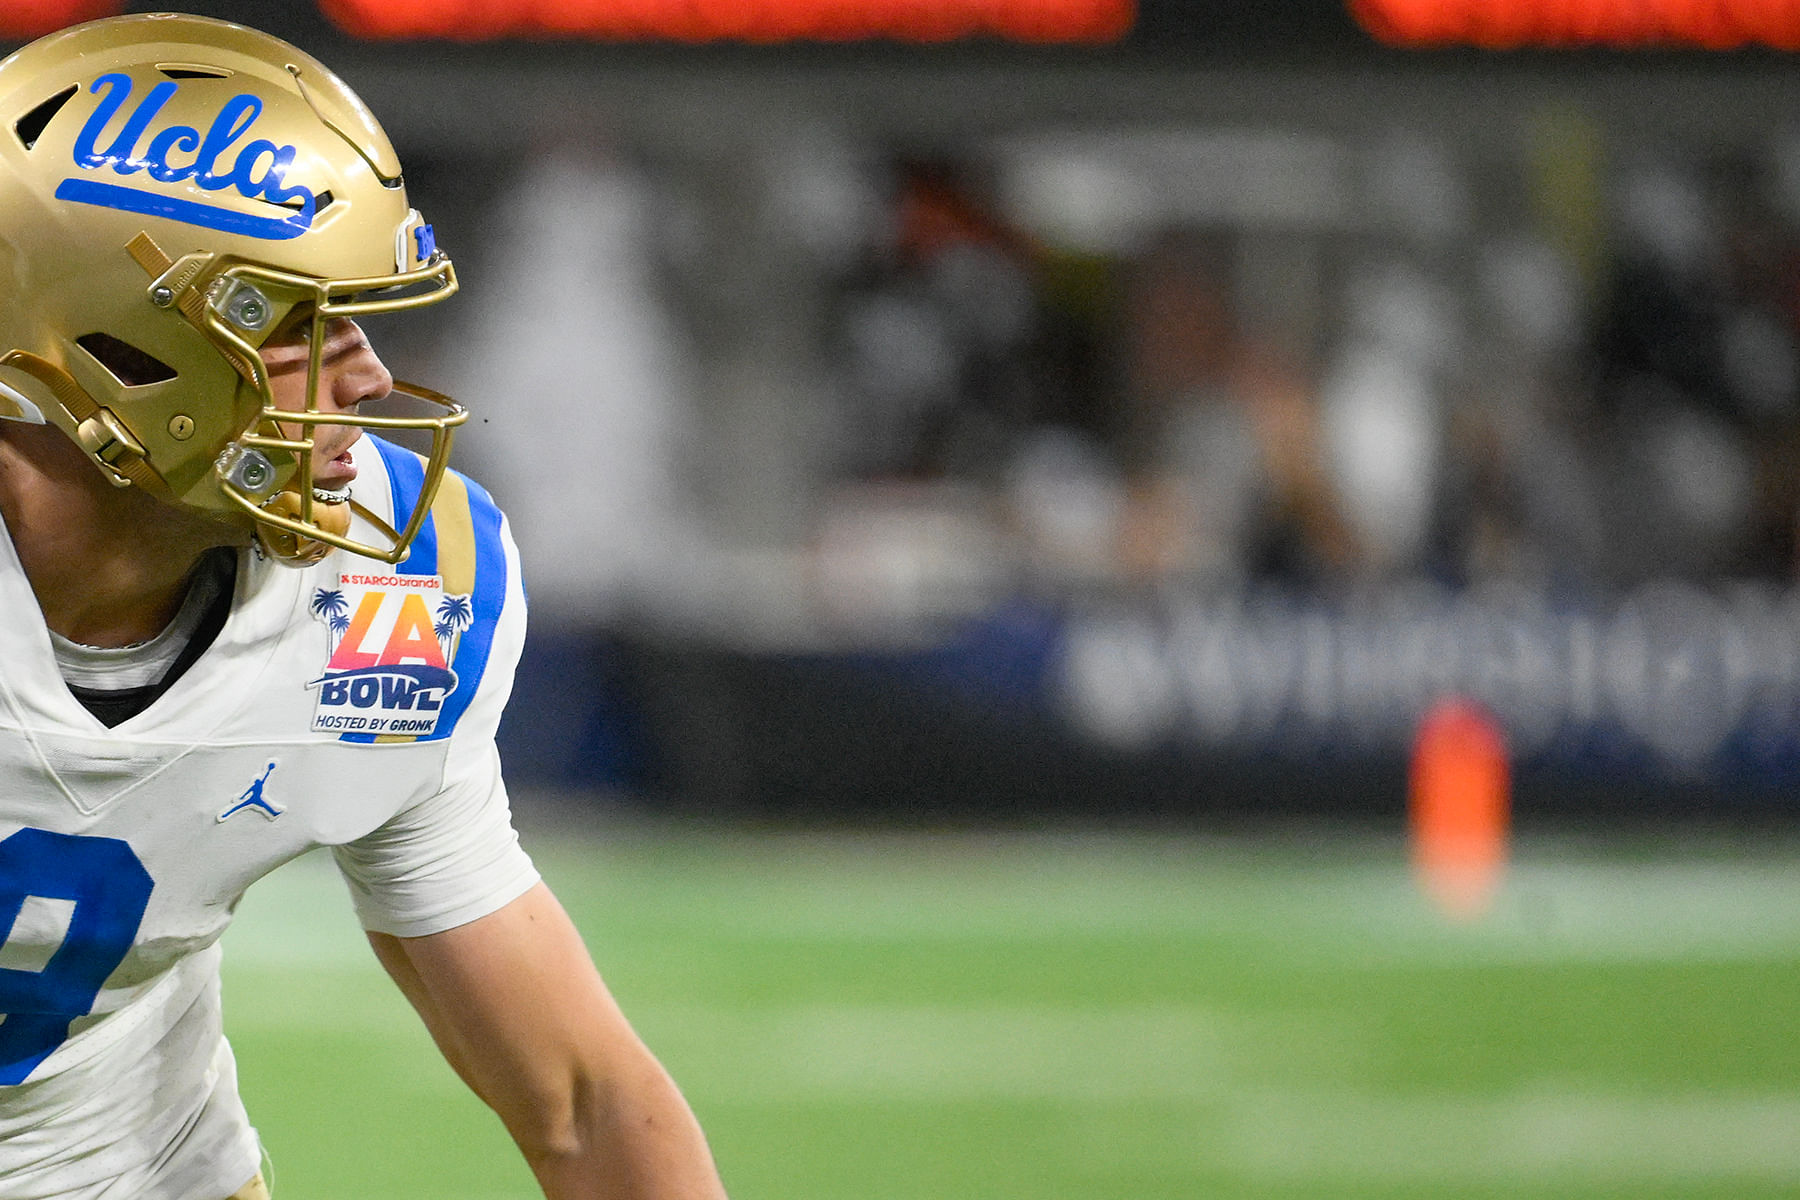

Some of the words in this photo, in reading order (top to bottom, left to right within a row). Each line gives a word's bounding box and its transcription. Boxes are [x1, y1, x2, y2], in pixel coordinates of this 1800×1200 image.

[327, 591, 449, 671] LA
[321, 673, 443, 711] BOWL
[315, 715, 367, 730] HOSTED
[369, 717, 390, 730] BY
[390, 718, 435, 732] GRONK
